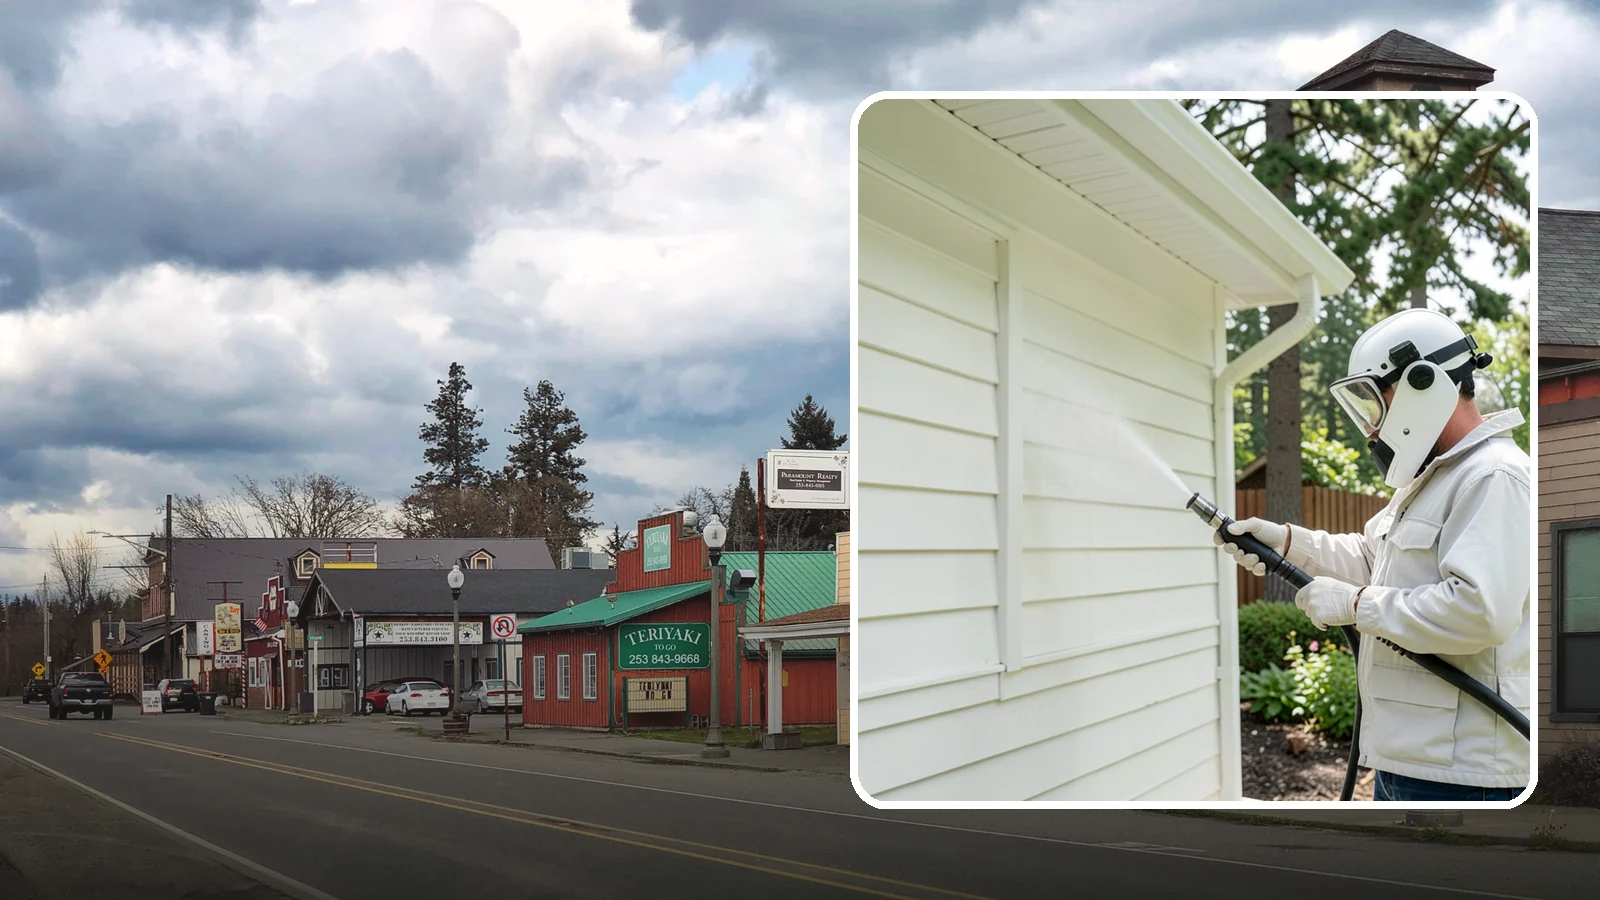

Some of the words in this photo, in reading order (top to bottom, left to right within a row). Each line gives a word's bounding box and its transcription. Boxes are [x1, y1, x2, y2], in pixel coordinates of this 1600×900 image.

[625, 627, 702, 646] TERIYAKI
[628, 654, 648, 664] 253
[651, 653, 700, 664] 843-9668
[639, 681, 672, 690] TERIYAKI
